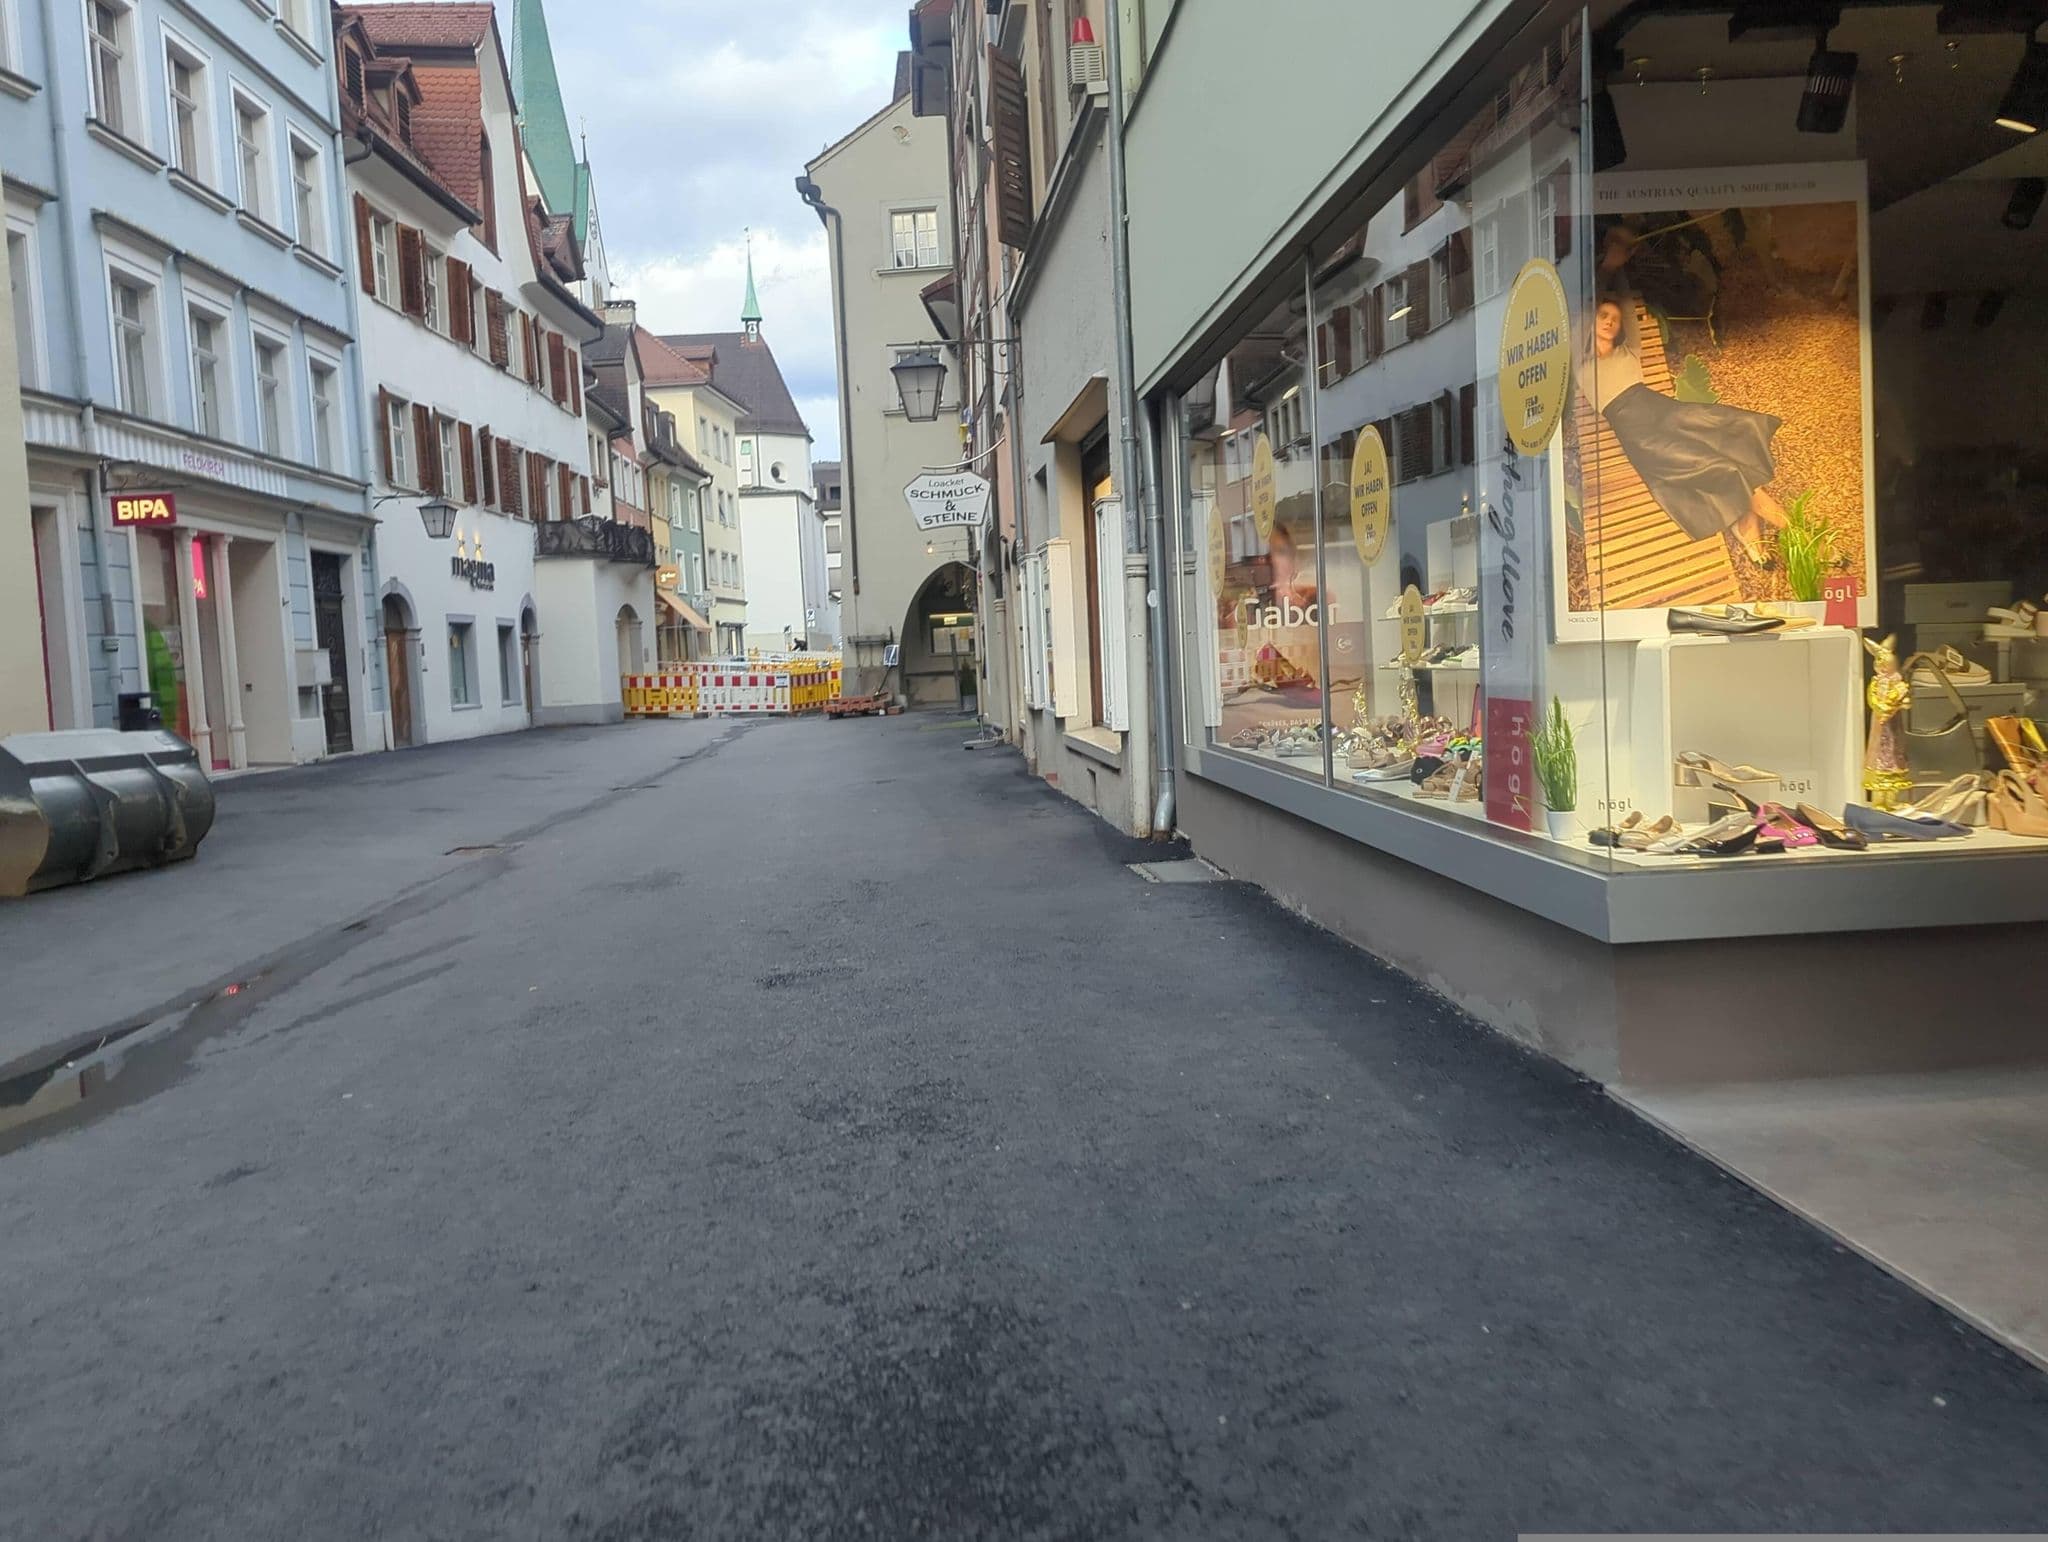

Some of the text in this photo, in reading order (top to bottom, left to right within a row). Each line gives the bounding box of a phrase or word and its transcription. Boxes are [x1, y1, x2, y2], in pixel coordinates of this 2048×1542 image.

[1626, 186, 1683, 200] AUSTRIAN
[1687, 184, 1736, 199] QUALITY
[1524, 307, 1539, 331] JA!
[1507, 327, 1559, 367] WIR HABEN
[1519, 361, 1547, 389] OFFEN
[910, 482, 985, 499] SCHMUCK
[116, 499, 170, 520] BIPA
[945, 500, 957, 512] &
[923, 512, 978, 526] STEINE
